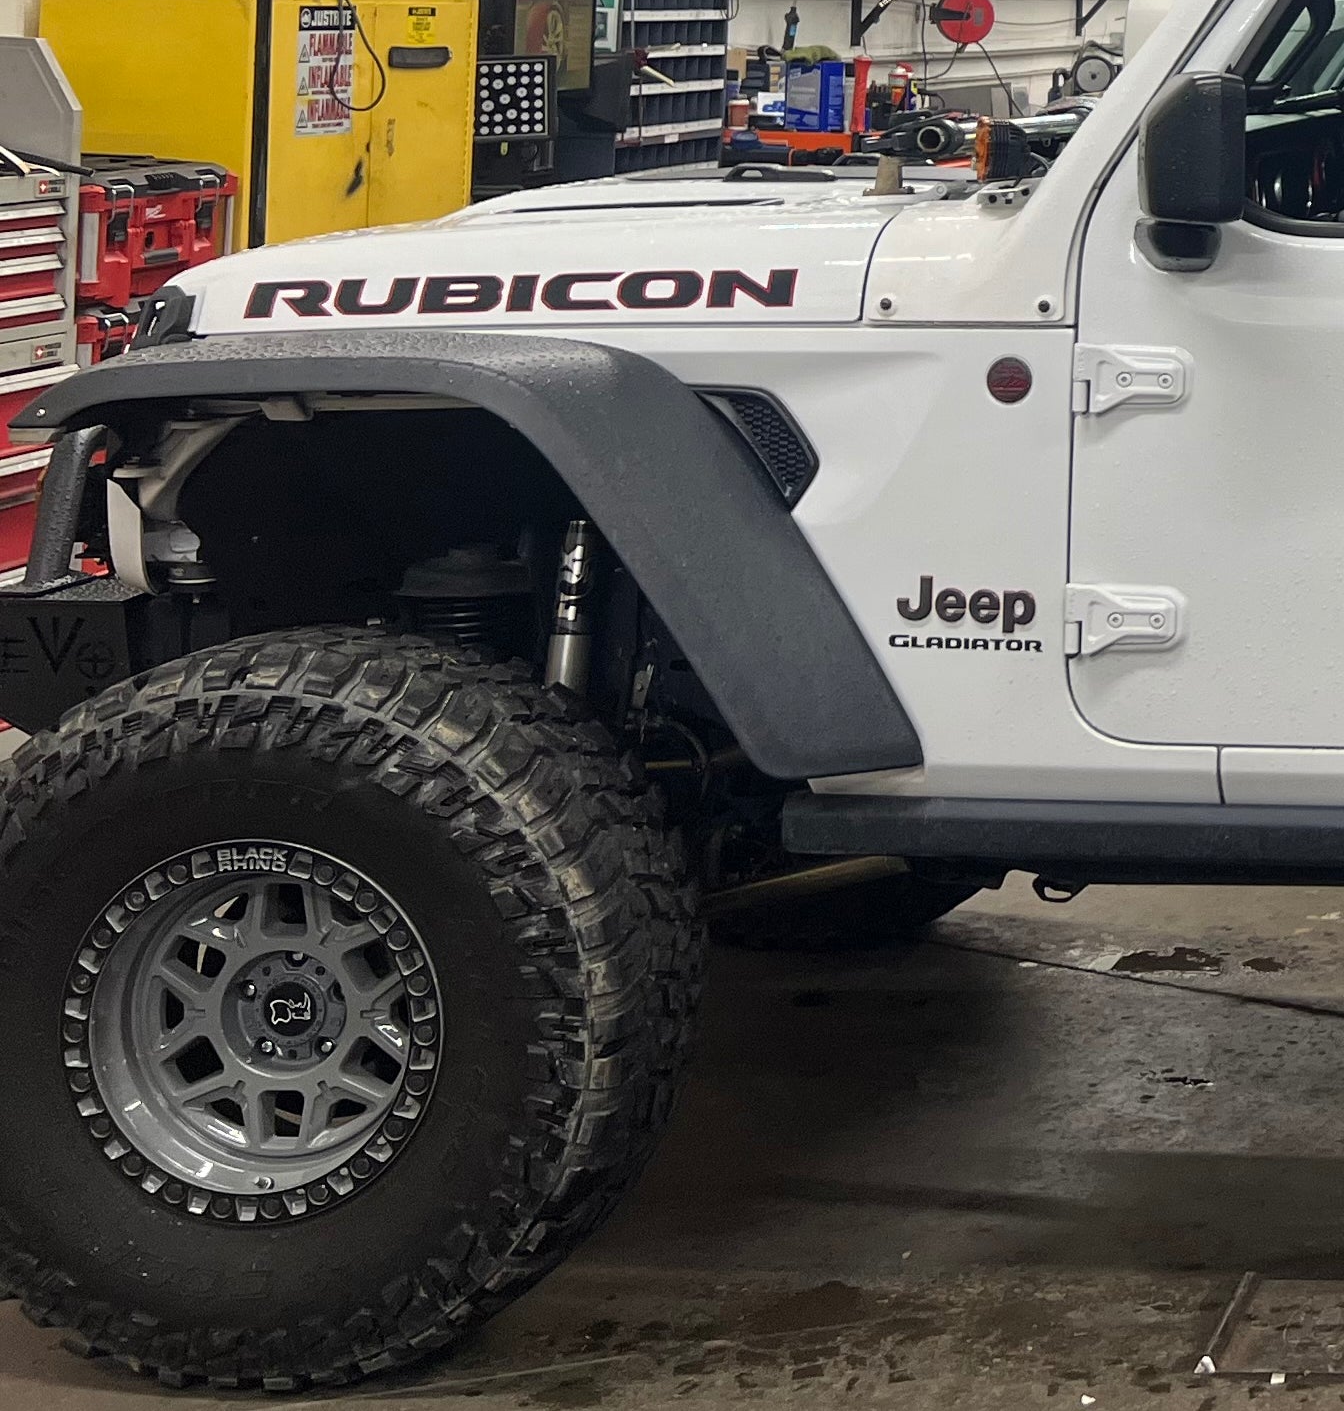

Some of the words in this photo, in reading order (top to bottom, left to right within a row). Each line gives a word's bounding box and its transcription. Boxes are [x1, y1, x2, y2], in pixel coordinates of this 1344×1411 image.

[311, 9, 352, 27] JUSTRTE
[243, 268, 799, 319] RUBICON
[897, 575, 1036, 633] Jeep
[889, 634, 1043, 653] GLADIATOR
[217, 847, 288, 862] BLACK
[218, 858, 287, 872] RHINO
